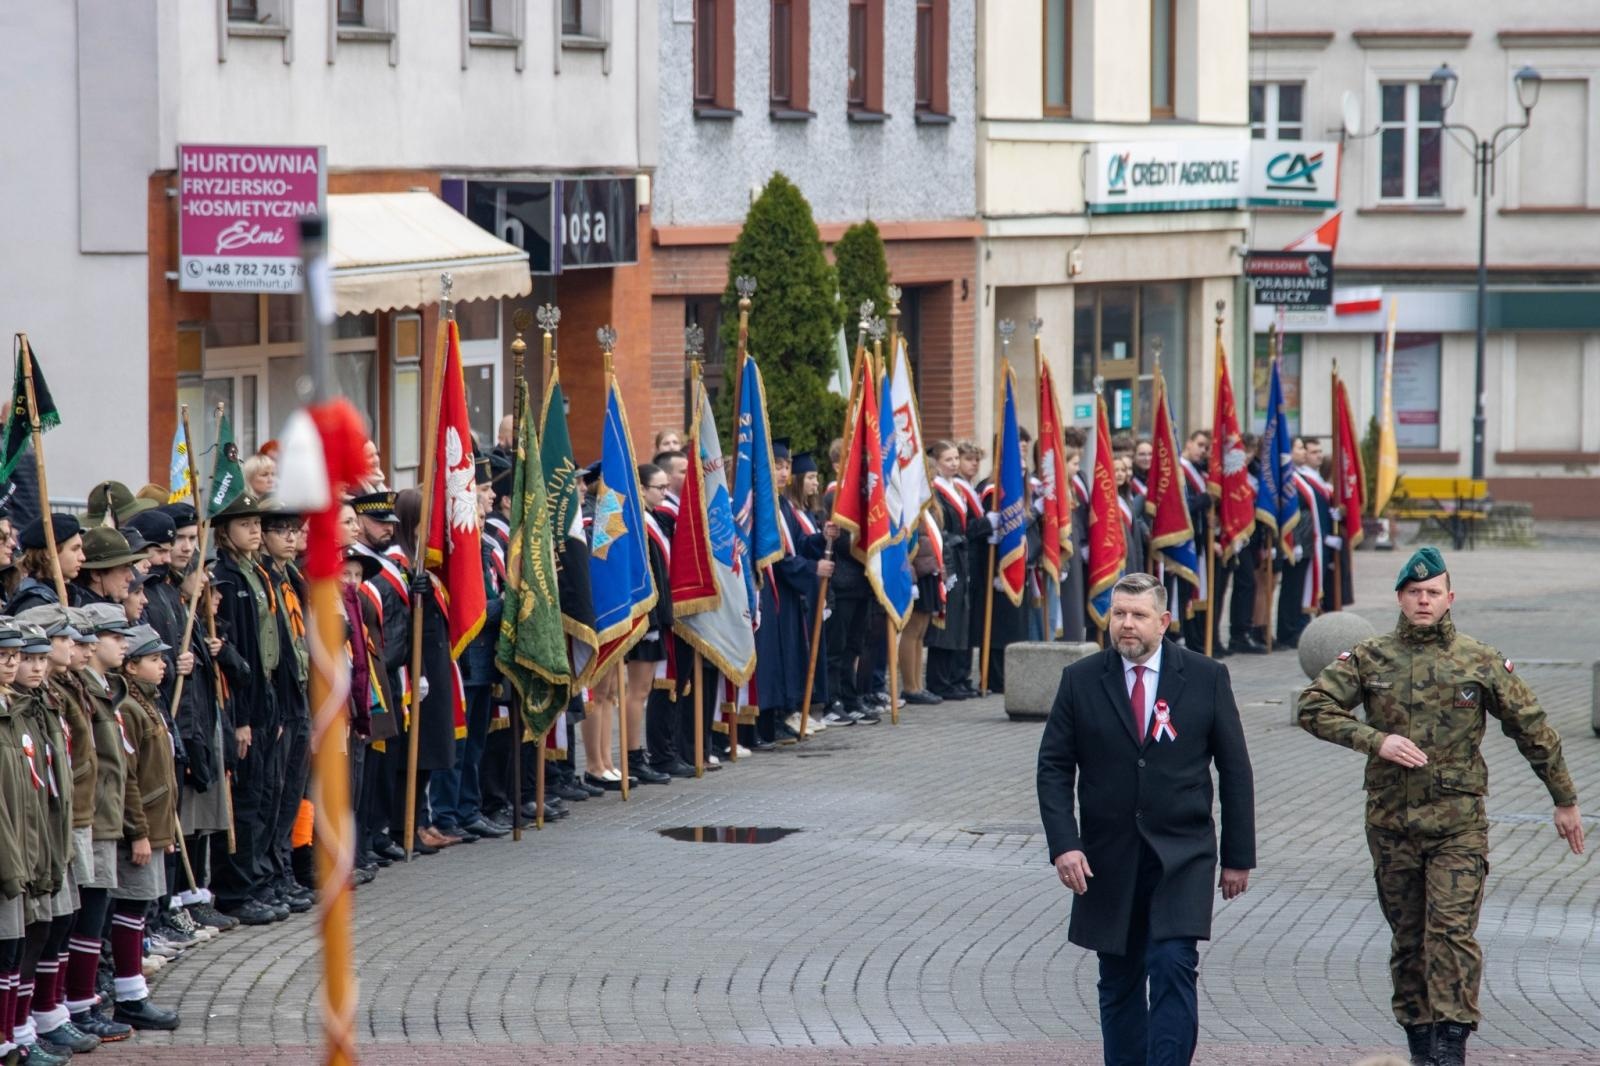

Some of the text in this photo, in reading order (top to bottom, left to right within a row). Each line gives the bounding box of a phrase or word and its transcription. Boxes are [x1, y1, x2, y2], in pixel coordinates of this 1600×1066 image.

[182, 153, 318, 174] HURTOWNIA
[1131, 158, 1239, 187] CRÉDIT AGRICOLE
[182, 178, 293, 196] FRYZJERSKO-
[182, 199, 319, 218] -KOSMETYCZNA
[215, 220, 285, 255] Elmi
[206, 263, 231, 277] +48
[235, 263, 258, 277] 782
[263, 263, 286, 277] 745
[207, 279, 293, 290] www.elmihurt.pl
[1252, 277, 1329, 290] ORABIANIE
[1260, 290, 1312, 303] KLUCZY
[213, 472, 234, 505] BOBRY
